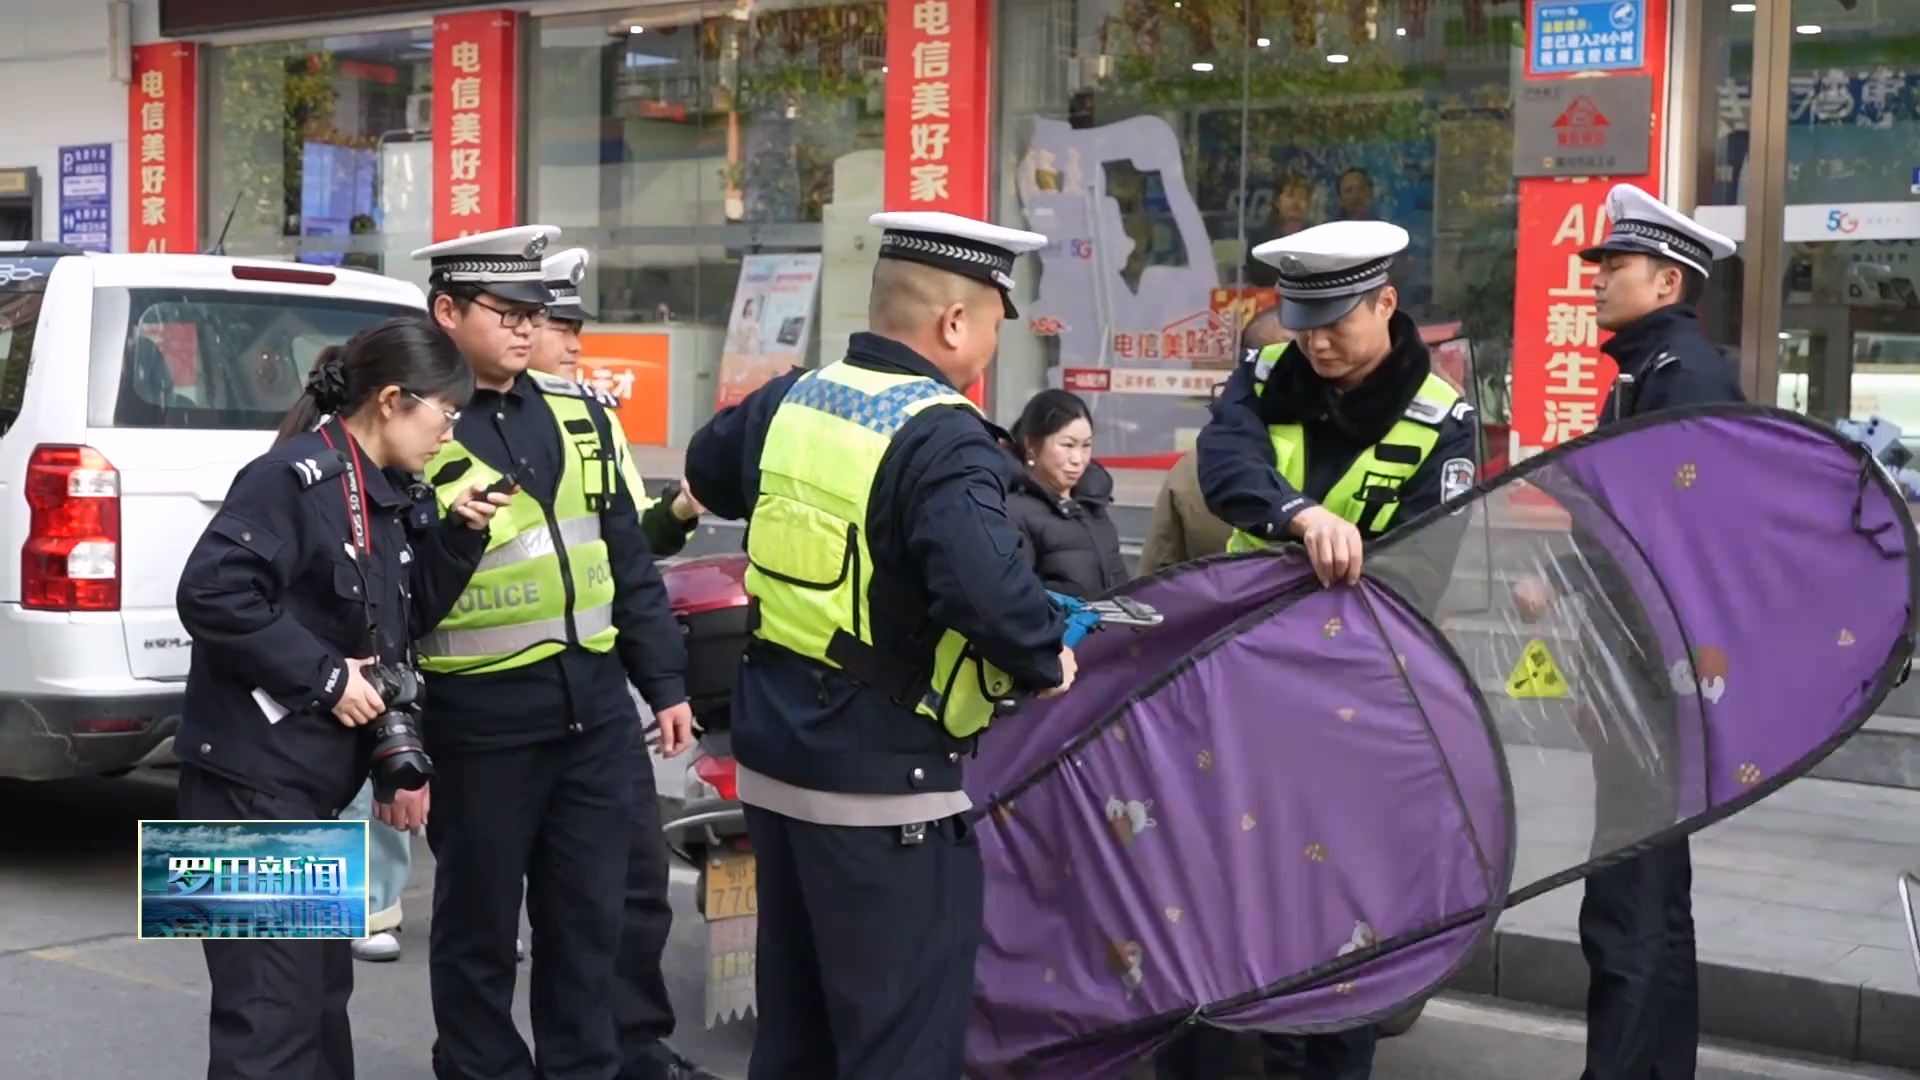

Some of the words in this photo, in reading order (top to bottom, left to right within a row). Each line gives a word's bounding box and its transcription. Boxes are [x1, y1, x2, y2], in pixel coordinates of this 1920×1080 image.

[141, 70, 166, 226] 电信美好家
[451, 41, 481, 216] 电信美好家
[911, 1, 950, 201] 电信美好家
[1827, 209, 1858, 233] 5G
[456, 580, 540, 613] OLICE
